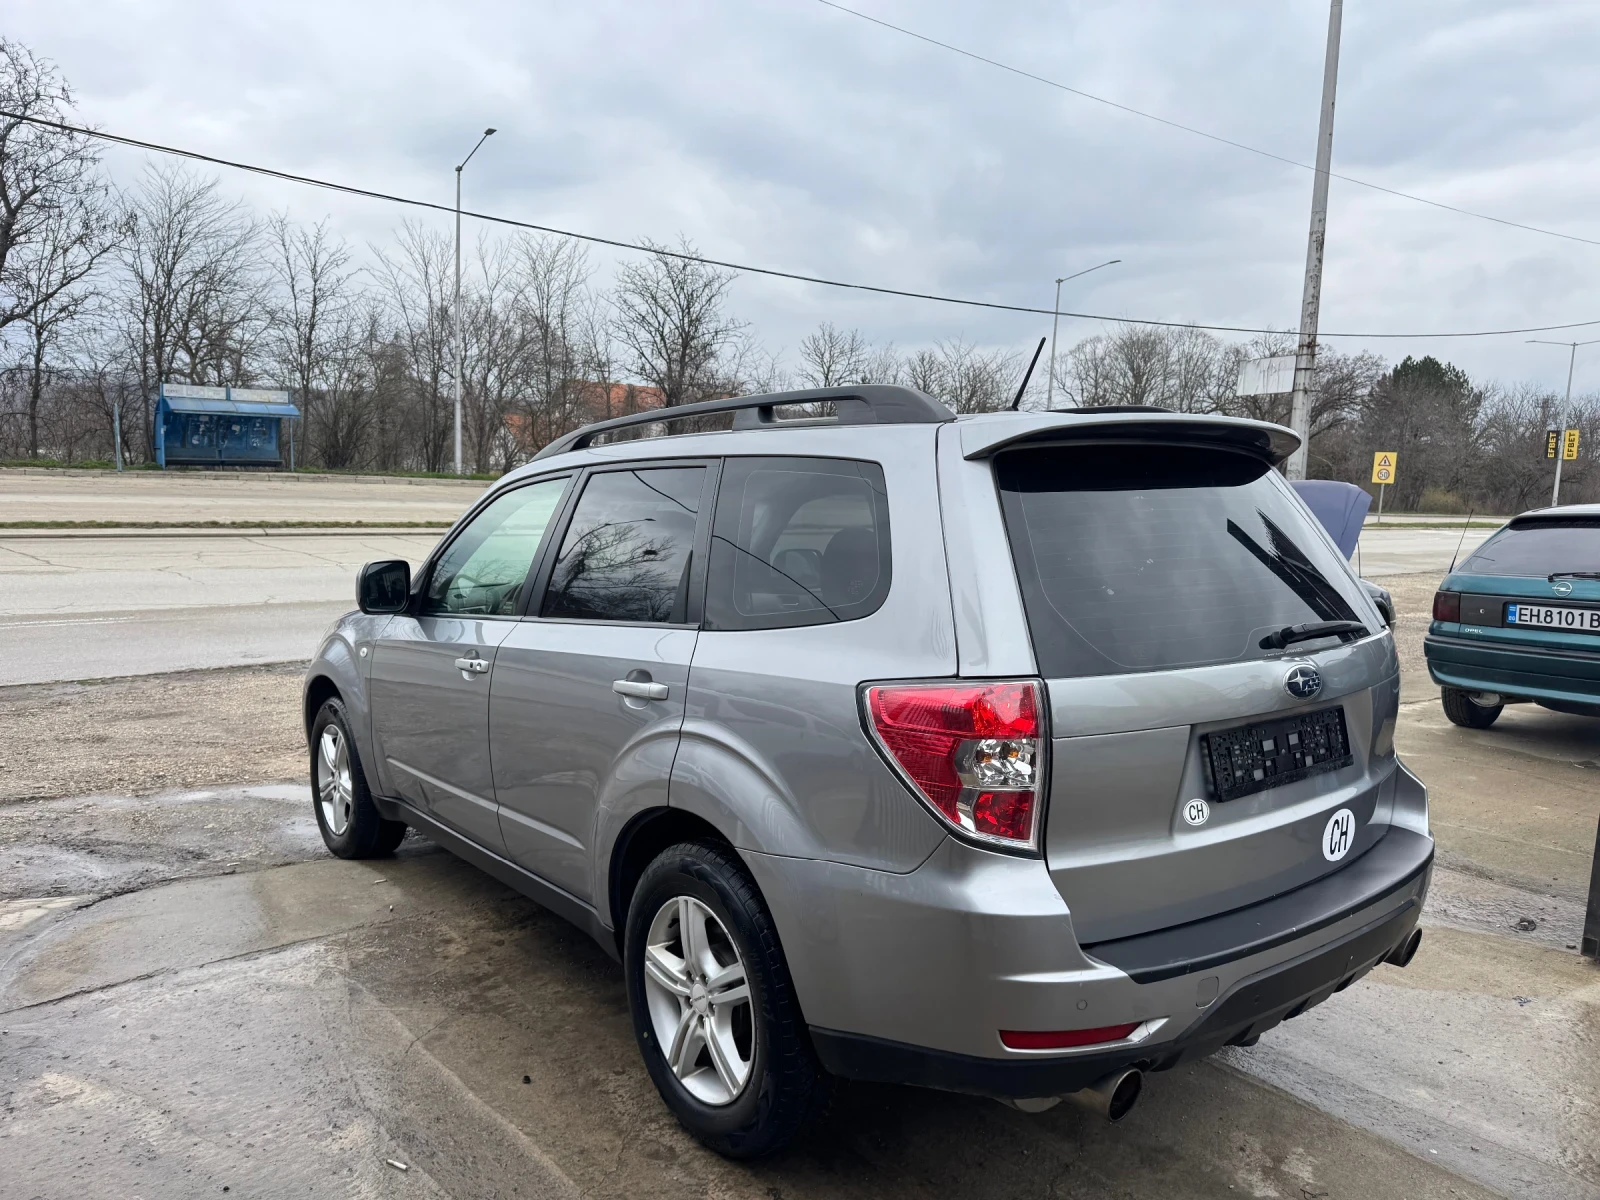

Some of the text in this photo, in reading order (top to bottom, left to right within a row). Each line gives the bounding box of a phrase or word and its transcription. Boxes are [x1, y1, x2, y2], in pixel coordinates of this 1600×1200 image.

[1547, 431, 1557, 458] EFBET
[1566, 432, 1576, 458] EFBET
[1188, 803, 1205, 821] CH
[1329, 814, 1350, 855] CH
